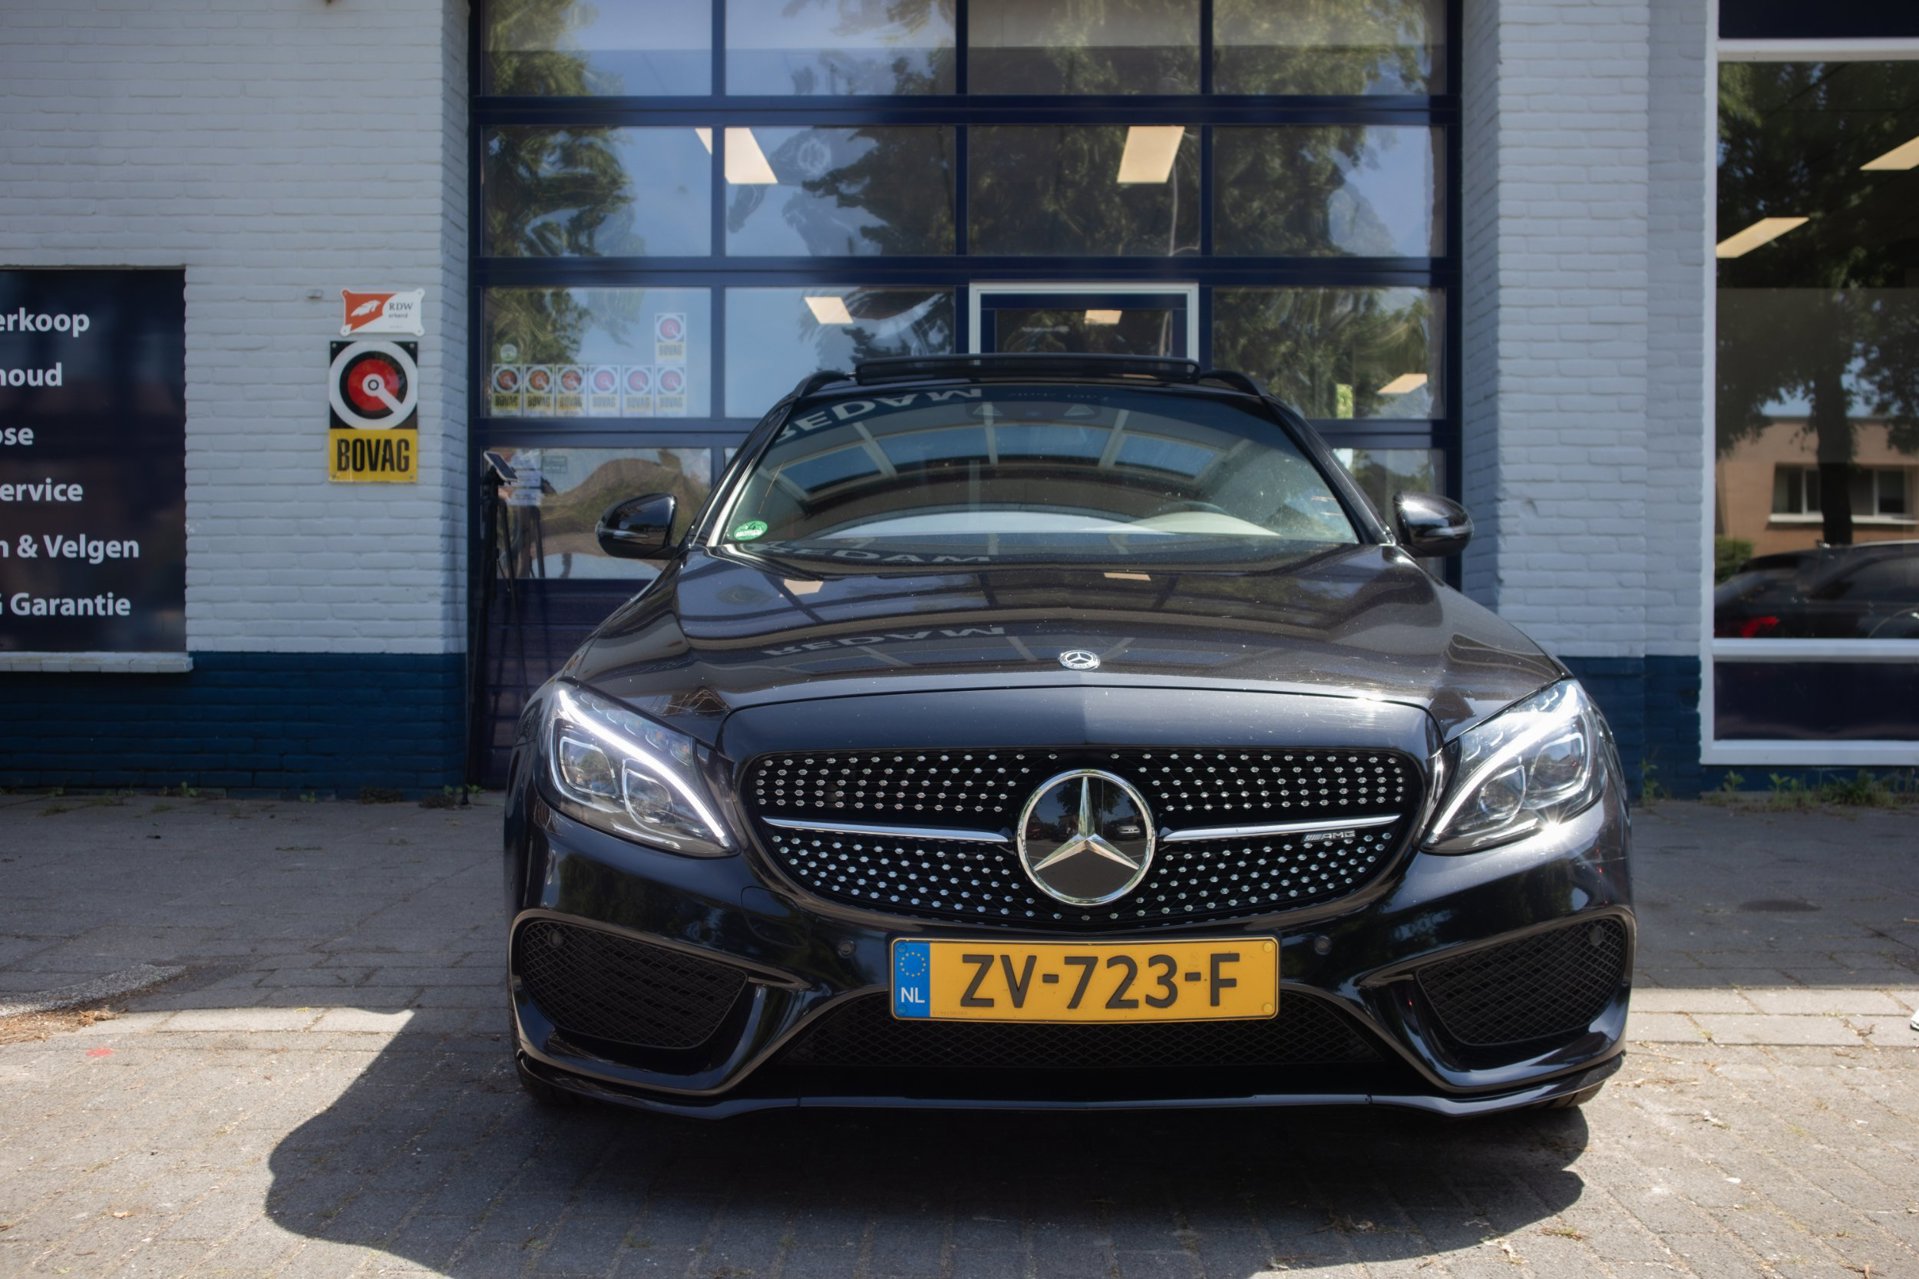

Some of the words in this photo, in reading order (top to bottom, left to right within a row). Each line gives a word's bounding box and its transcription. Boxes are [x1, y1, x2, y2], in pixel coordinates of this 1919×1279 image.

[389, 302, 413, 311] RDW
[0, 427, 34, 446] se
[337, 438, 410, 472] BOVAG
[17, 534, 38, 558] &
[43, 533, 139, 564] Velgen
[10, 592, 131, 616] Garantie
[1320, 830, 1355, 840] AMG
[960, 953, 1240, 1009] ZV-723-F
[900, 986, 925, 1004] NL
